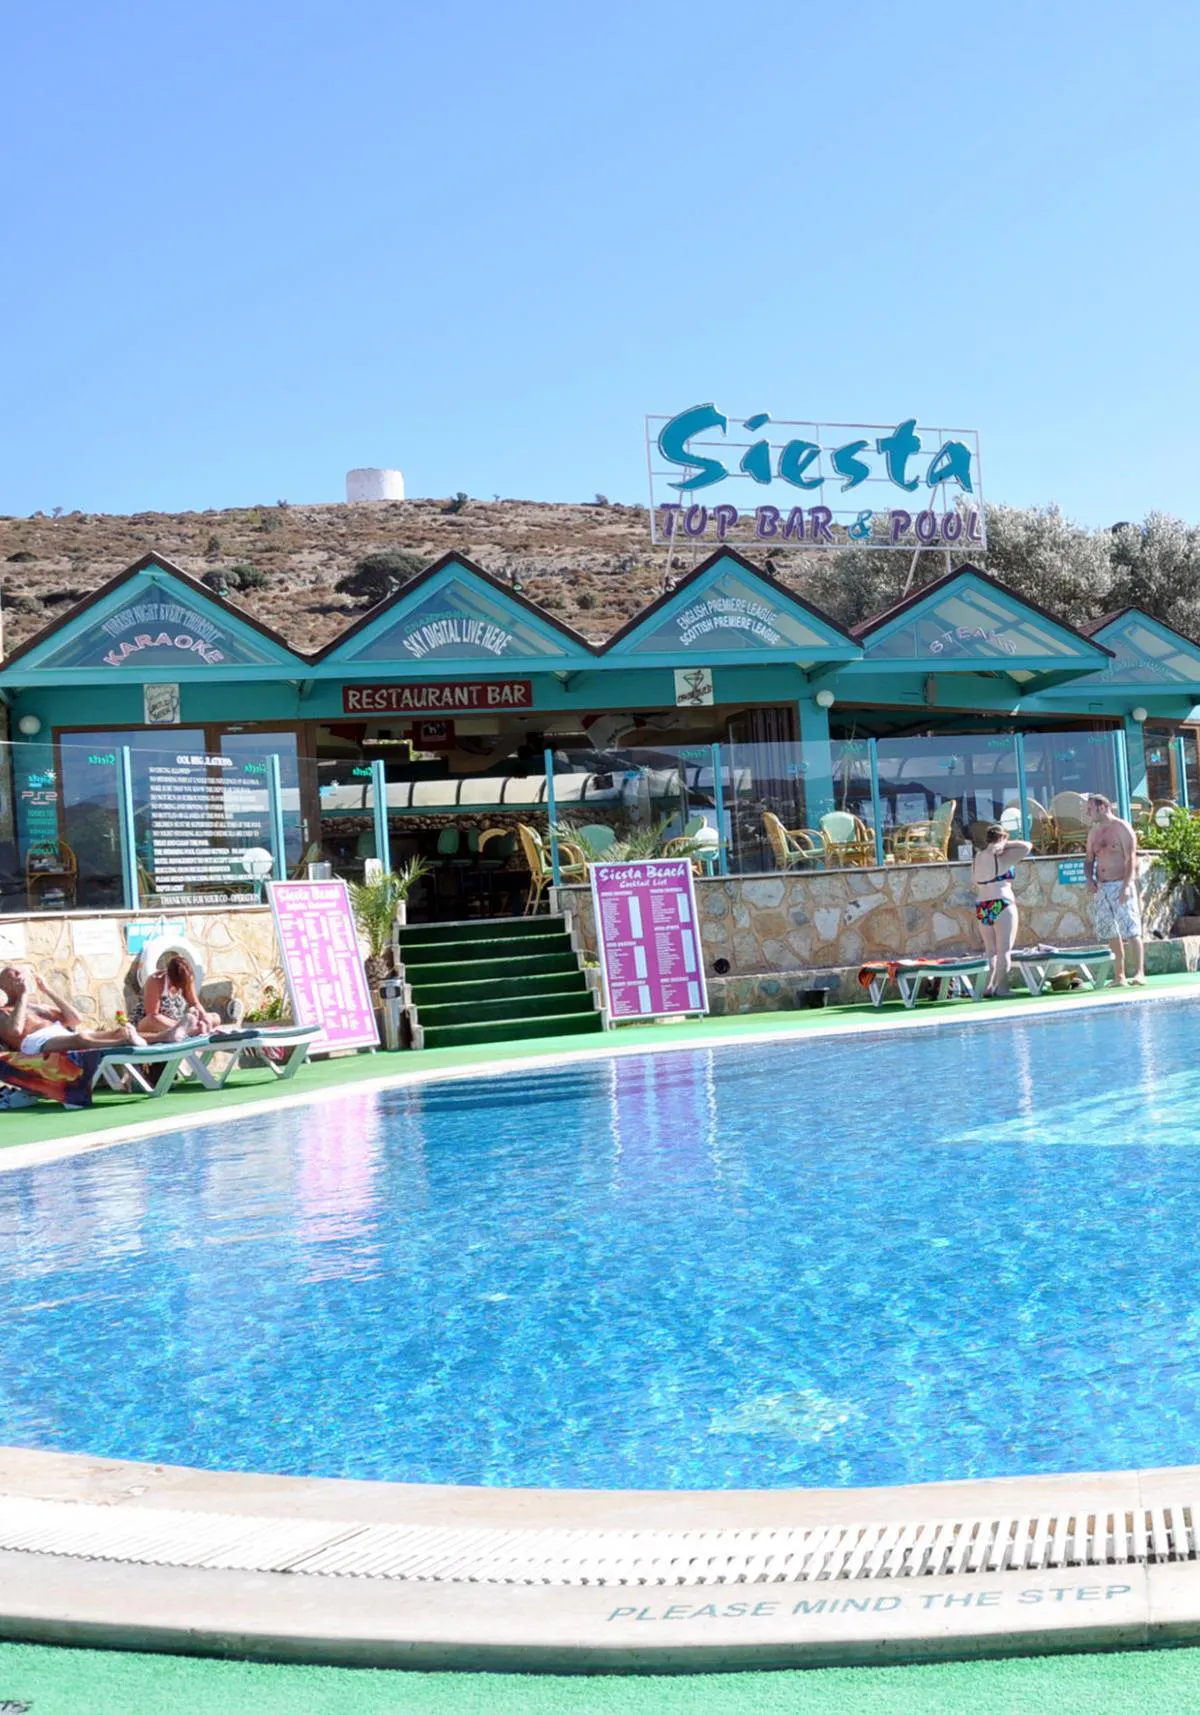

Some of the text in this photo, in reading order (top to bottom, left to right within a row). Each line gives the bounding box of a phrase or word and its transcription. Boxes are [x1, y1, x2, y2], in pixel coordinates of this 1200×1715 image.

[658, 402, 973, 493] Siesta
[660, 503, 983, 543] TOP BAR & POOL
[676, 598, 779, 630] ENGLISH PREMIERE LEAGUE
[102, 632, 225, 666] KARAOKE
[402, 630, 429, 659] SKY
[422, 619, 461, 649] DIGITAL
[462, 619, 484, 644] LIVE
[481, 624, 513, 656] HERE
[679, 618, 714, 646] SCOTTISH
[751, 621, 781, 645] LEAGUE
[347, 684, 527, 710] RESTAURANT BAR
[598, 864, 685, 882] Siesta Beach
[605, 1585, 1132, 1622] PLEASE MIND THE STEP
